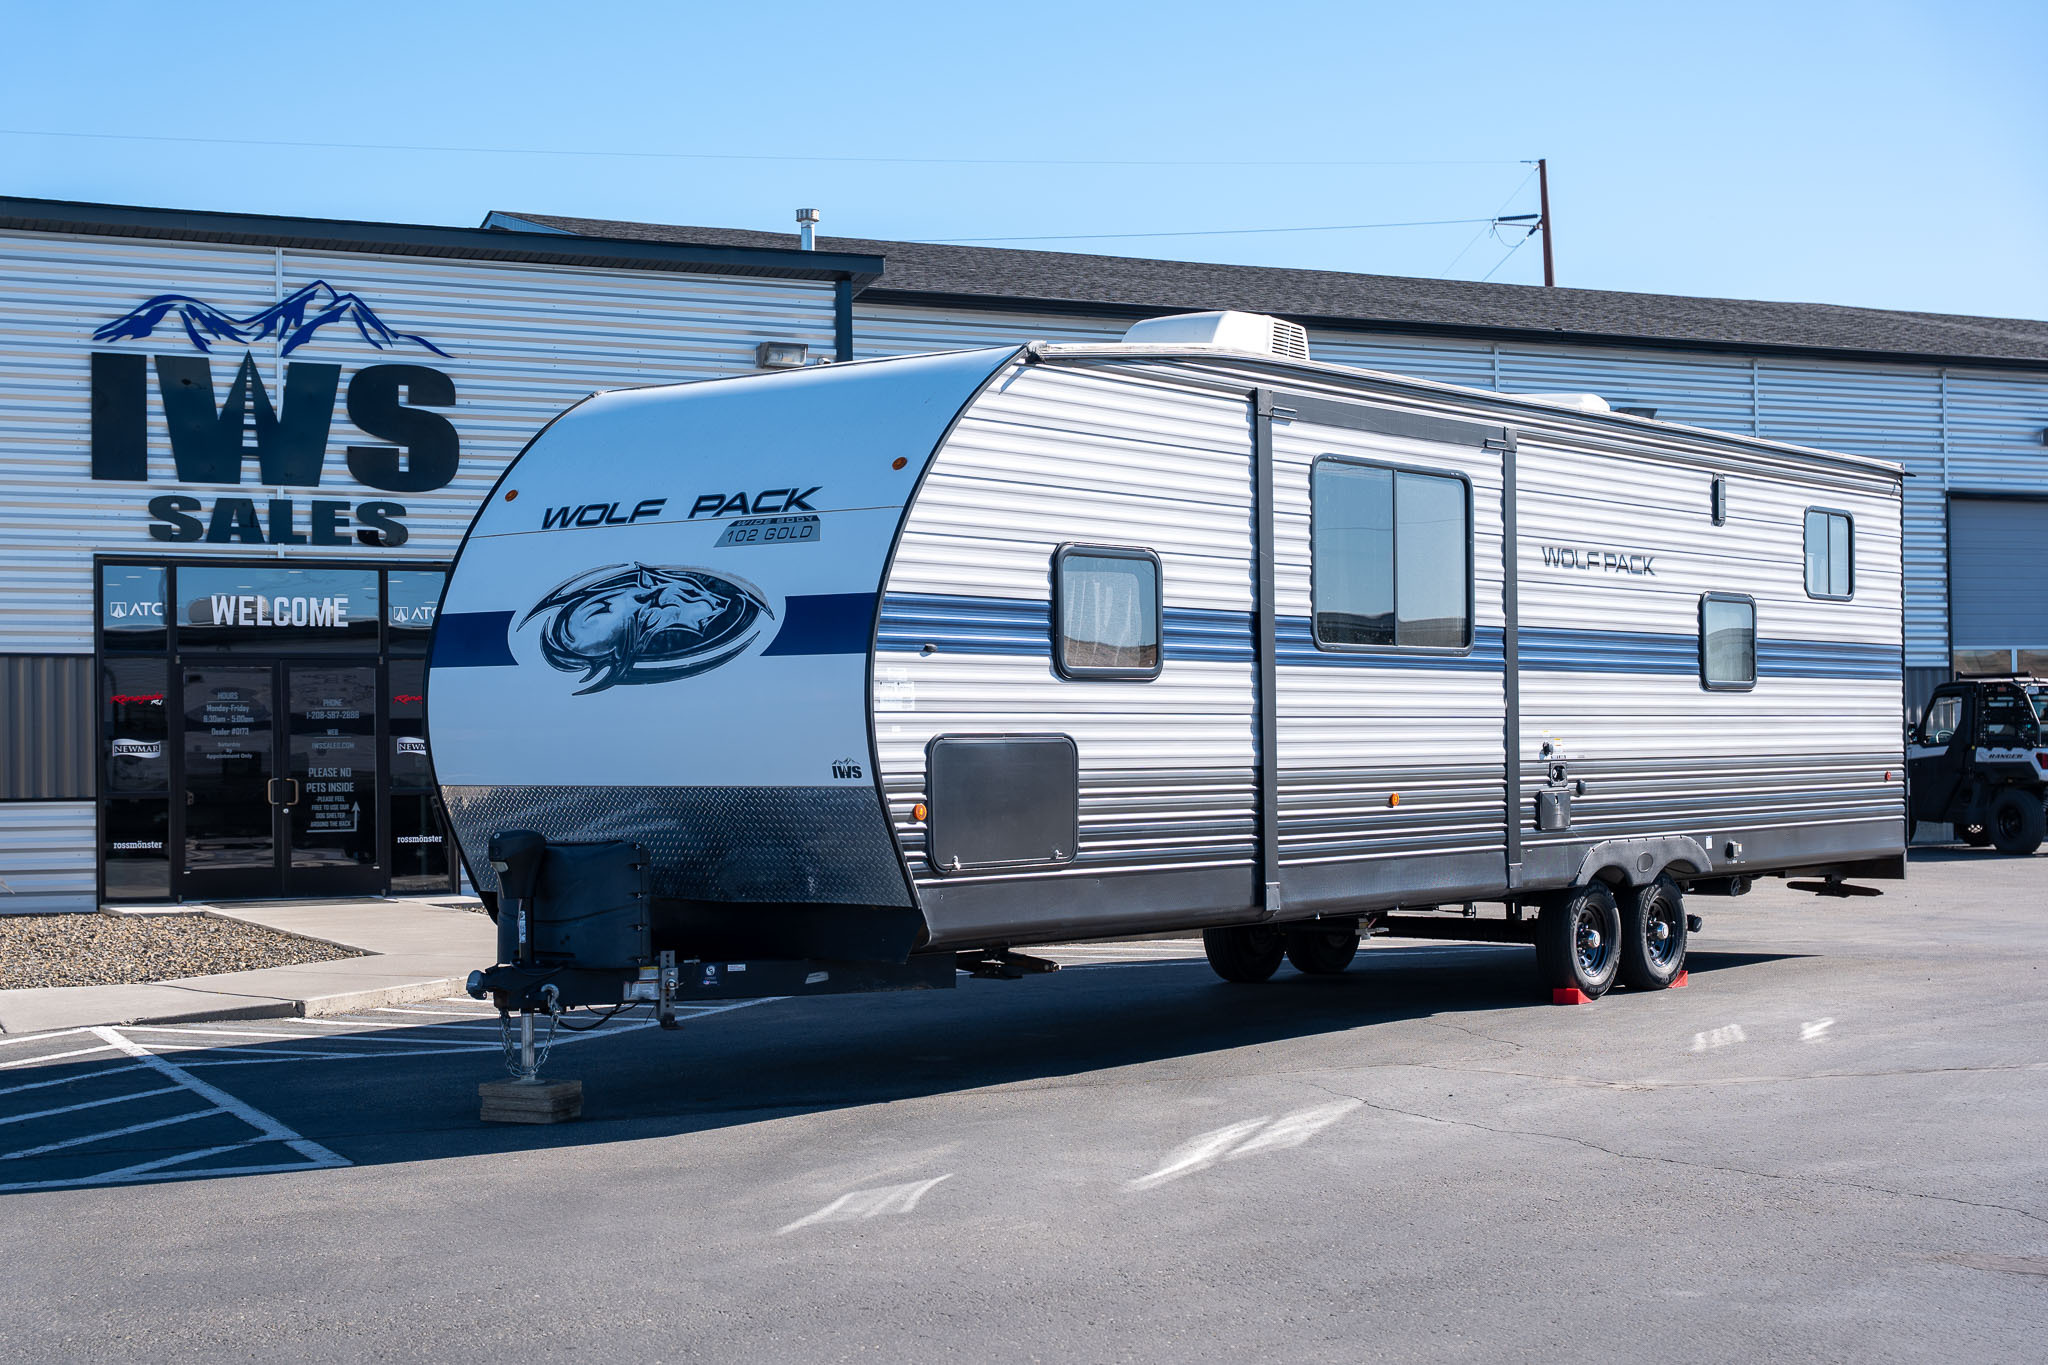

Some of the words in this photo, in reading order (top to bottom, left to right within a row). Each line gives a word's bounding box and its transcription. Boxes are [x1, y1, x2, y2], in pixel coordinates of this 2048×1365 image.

[91, 350, 460, 492] IWS
[542, 498, 668, 530] WOLF
[688, 486, 823, 518] PACK
[148, 495, 409, 547] SALES
[728, 529, 758, 543] 102
[764, 525, 813, 541] GOLD
[1541, 546, 1599, 570] WOLF
[1604, 552, 1655, 576] PACK
[129, 602, 163, 616] ATC
[211, 595, 348, 627] WELCOME
[114, 744, 159, 753] NEWMAR
[308, 768, 338, 777] PLEASE
[340, 768, 352, 777] NO
[832, 765, 862, 779] IWS
[306, 783, 327, 792] PETS
[328, 782, 354, 792] INSIDE
[113, 841, 163, 849] rossmönster
[397, 835, 443, 843] rossmönster
